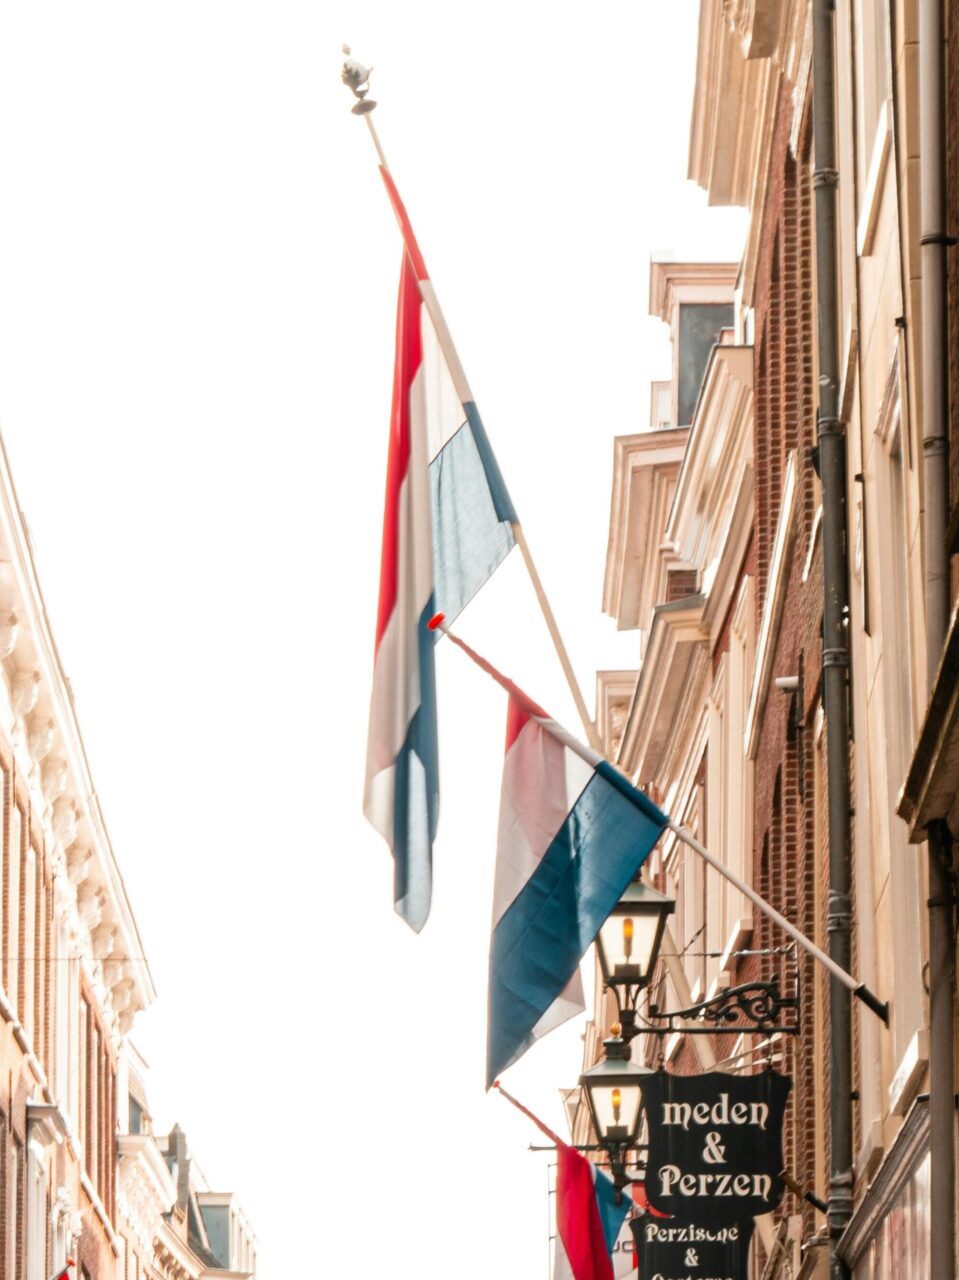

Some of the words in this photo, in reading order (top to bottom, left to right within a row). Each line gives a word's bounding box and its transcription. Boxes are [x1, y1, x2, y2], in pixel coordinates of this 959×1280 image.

[702, 1131, 727, 1164] &
[659, 1164, 772, 1202] Perzen
[684, 1248, 699, 1267] &
